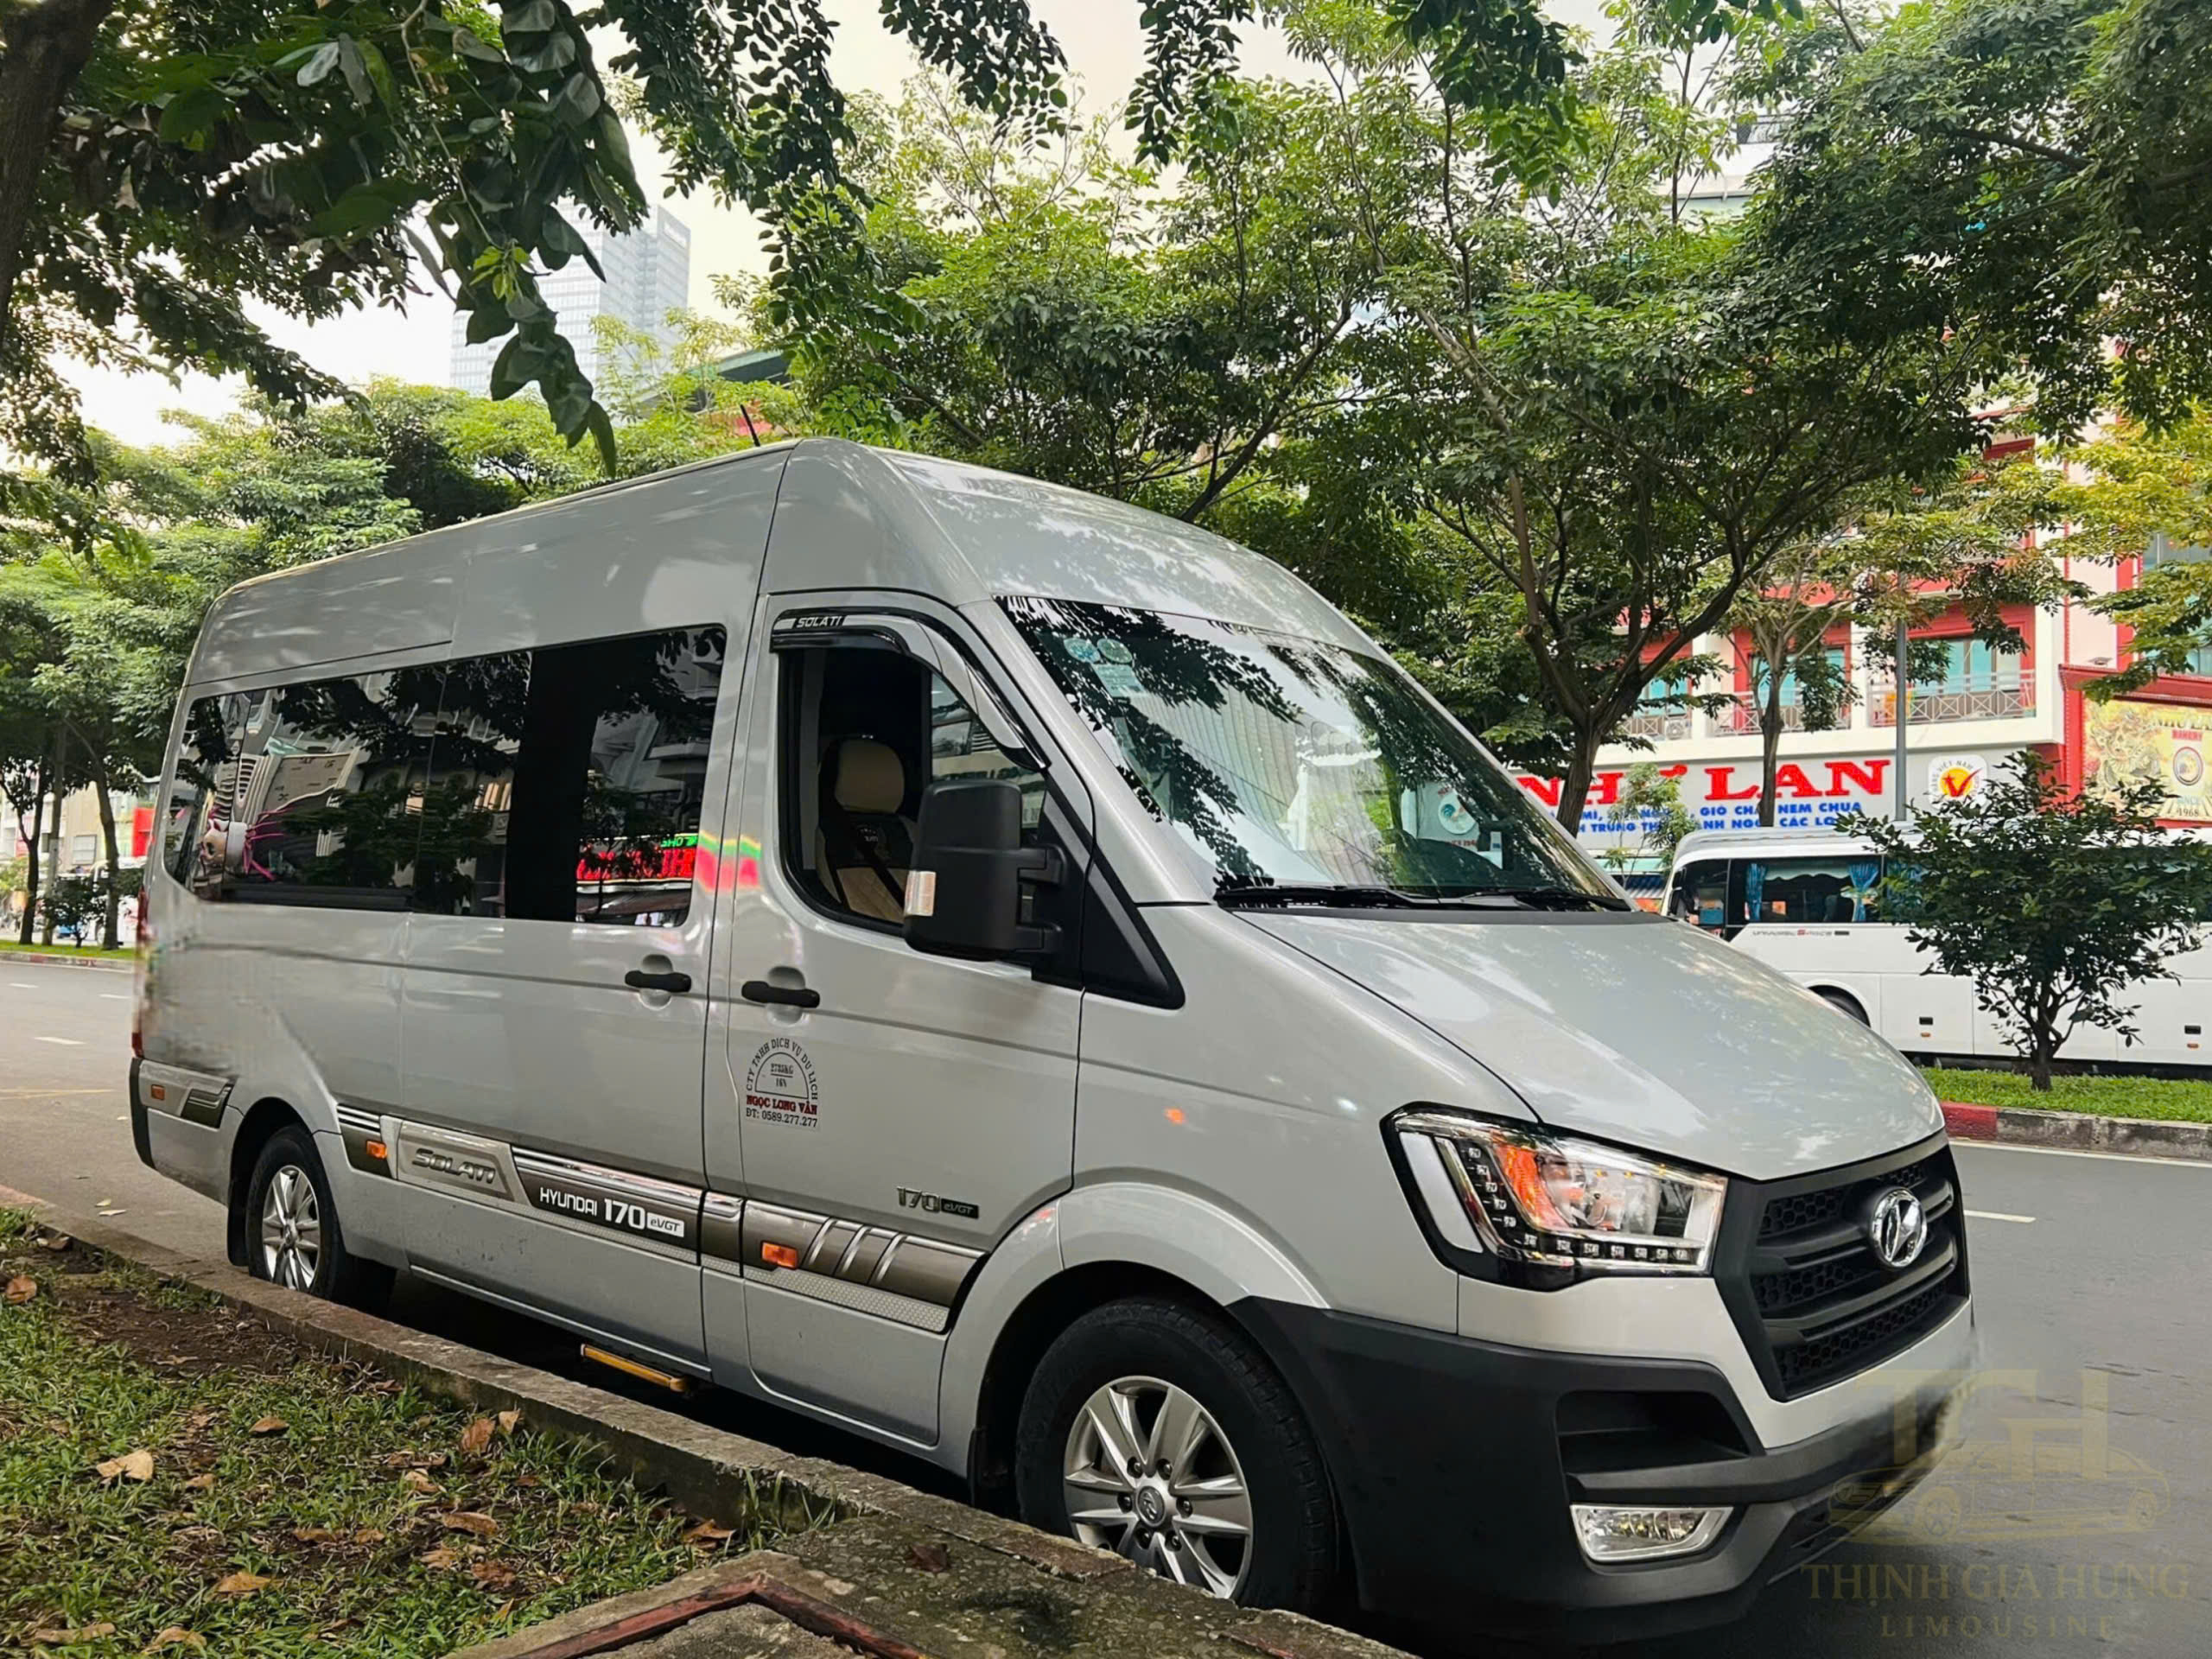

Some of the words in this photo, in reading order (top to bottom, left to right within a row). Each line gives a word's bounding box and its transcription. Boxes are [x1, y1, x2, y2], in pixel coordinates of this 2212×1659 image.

[796, 615, 842, 628] SOLATI
[1516, 764, 1688, 806] NH
[1704, 760, 1891, 801] LAN
[1734, 804, 1759, 816] CH
[1777, 804, 1812, 814] NEM
[2177, 807, 2200, 817] 1968
[1591, 823, 1637, 832] TRUNG
[752, 1043, 770, 1067] TNHH
[772, 1098, 796, 1112] LONG
[761, 1110, 818, 1128] 0589.277.277
[412, 1147, 496, 1184] SOLATI
[897, 1185, 941, 1213] 170
[539, 1186, 597, 1217] HYUNDAI
[605, 1198, 645, 1230] 170
[650, 1218, 681, 1232] eVGT
